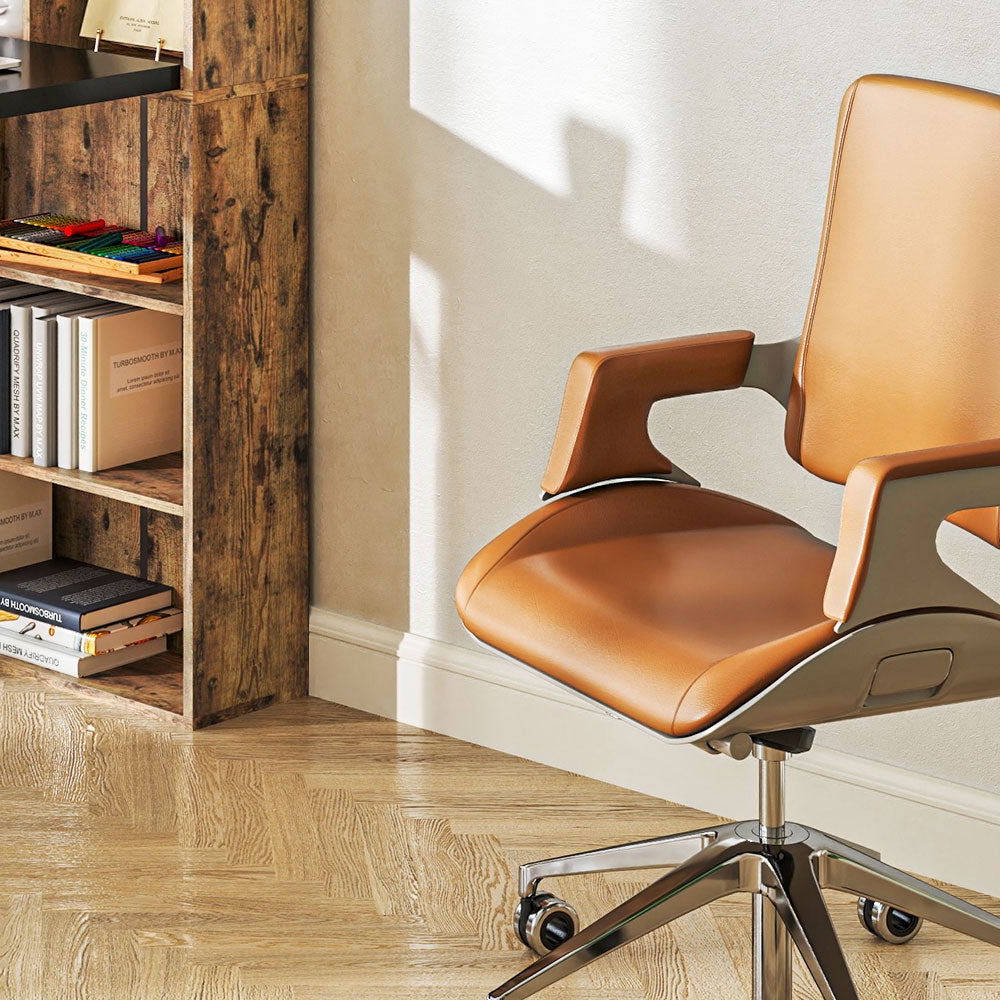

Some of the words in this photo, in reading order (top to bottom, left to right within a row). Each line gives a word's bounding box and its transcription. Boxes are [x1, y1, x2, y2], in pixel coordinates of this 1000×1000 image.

[13, 329, 21, 376] QUADRIFY
[80, 331, 88, 377] 30-Minute
[112, 352, 160, 369] TURBOSMOOTH
[160, 350, 169, 359] BY
[13, 376, 21, 402] MESH
[80, 379, 88, 412] Dinner
[13, 402, 21, 416] BY
[80, 412, 88, 450] Recipes
[1, 597, 10, 607] BY
[11, 599, 62, 623] TURBOSMOOTH
[2, 643, 23, 655] MESH
[24, 649, 60, 667] QUADRIFY
